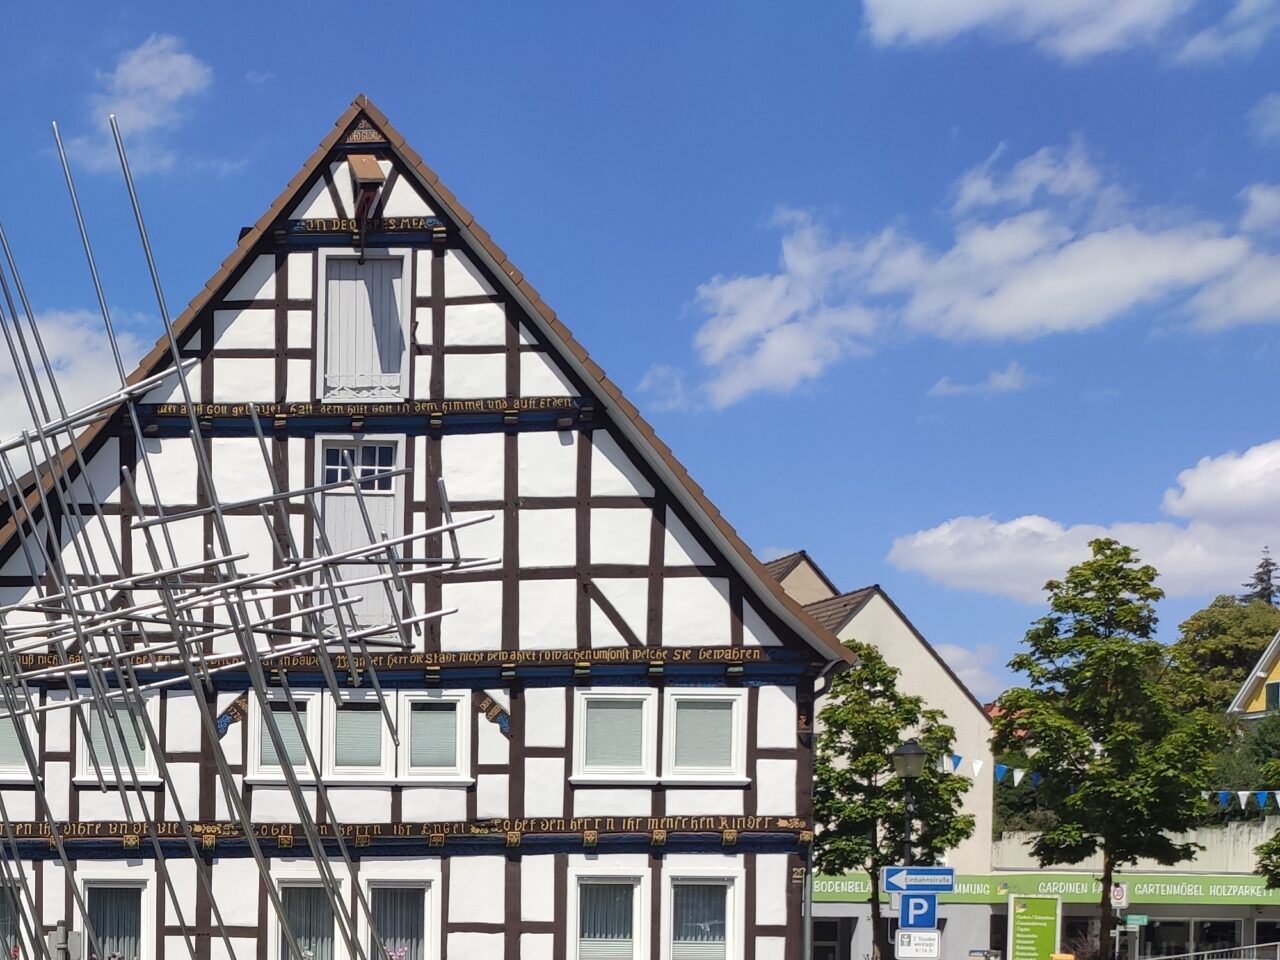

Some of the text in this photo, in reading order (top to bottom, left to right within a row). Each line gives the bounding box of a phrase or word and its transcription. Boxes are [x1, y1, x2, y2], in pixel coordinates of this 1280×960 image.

[904, 875, 951, 884] Einbahnstraße
[813, 880, 871, 893] BODENBELÄ
[954, 883, 990, 895] MMUNG
[1038, 882, 1088, 894] GARDINEN
[1134, 882, 1205, 896] GARTENMÖBEL
[908, 898, 928, 925] P
